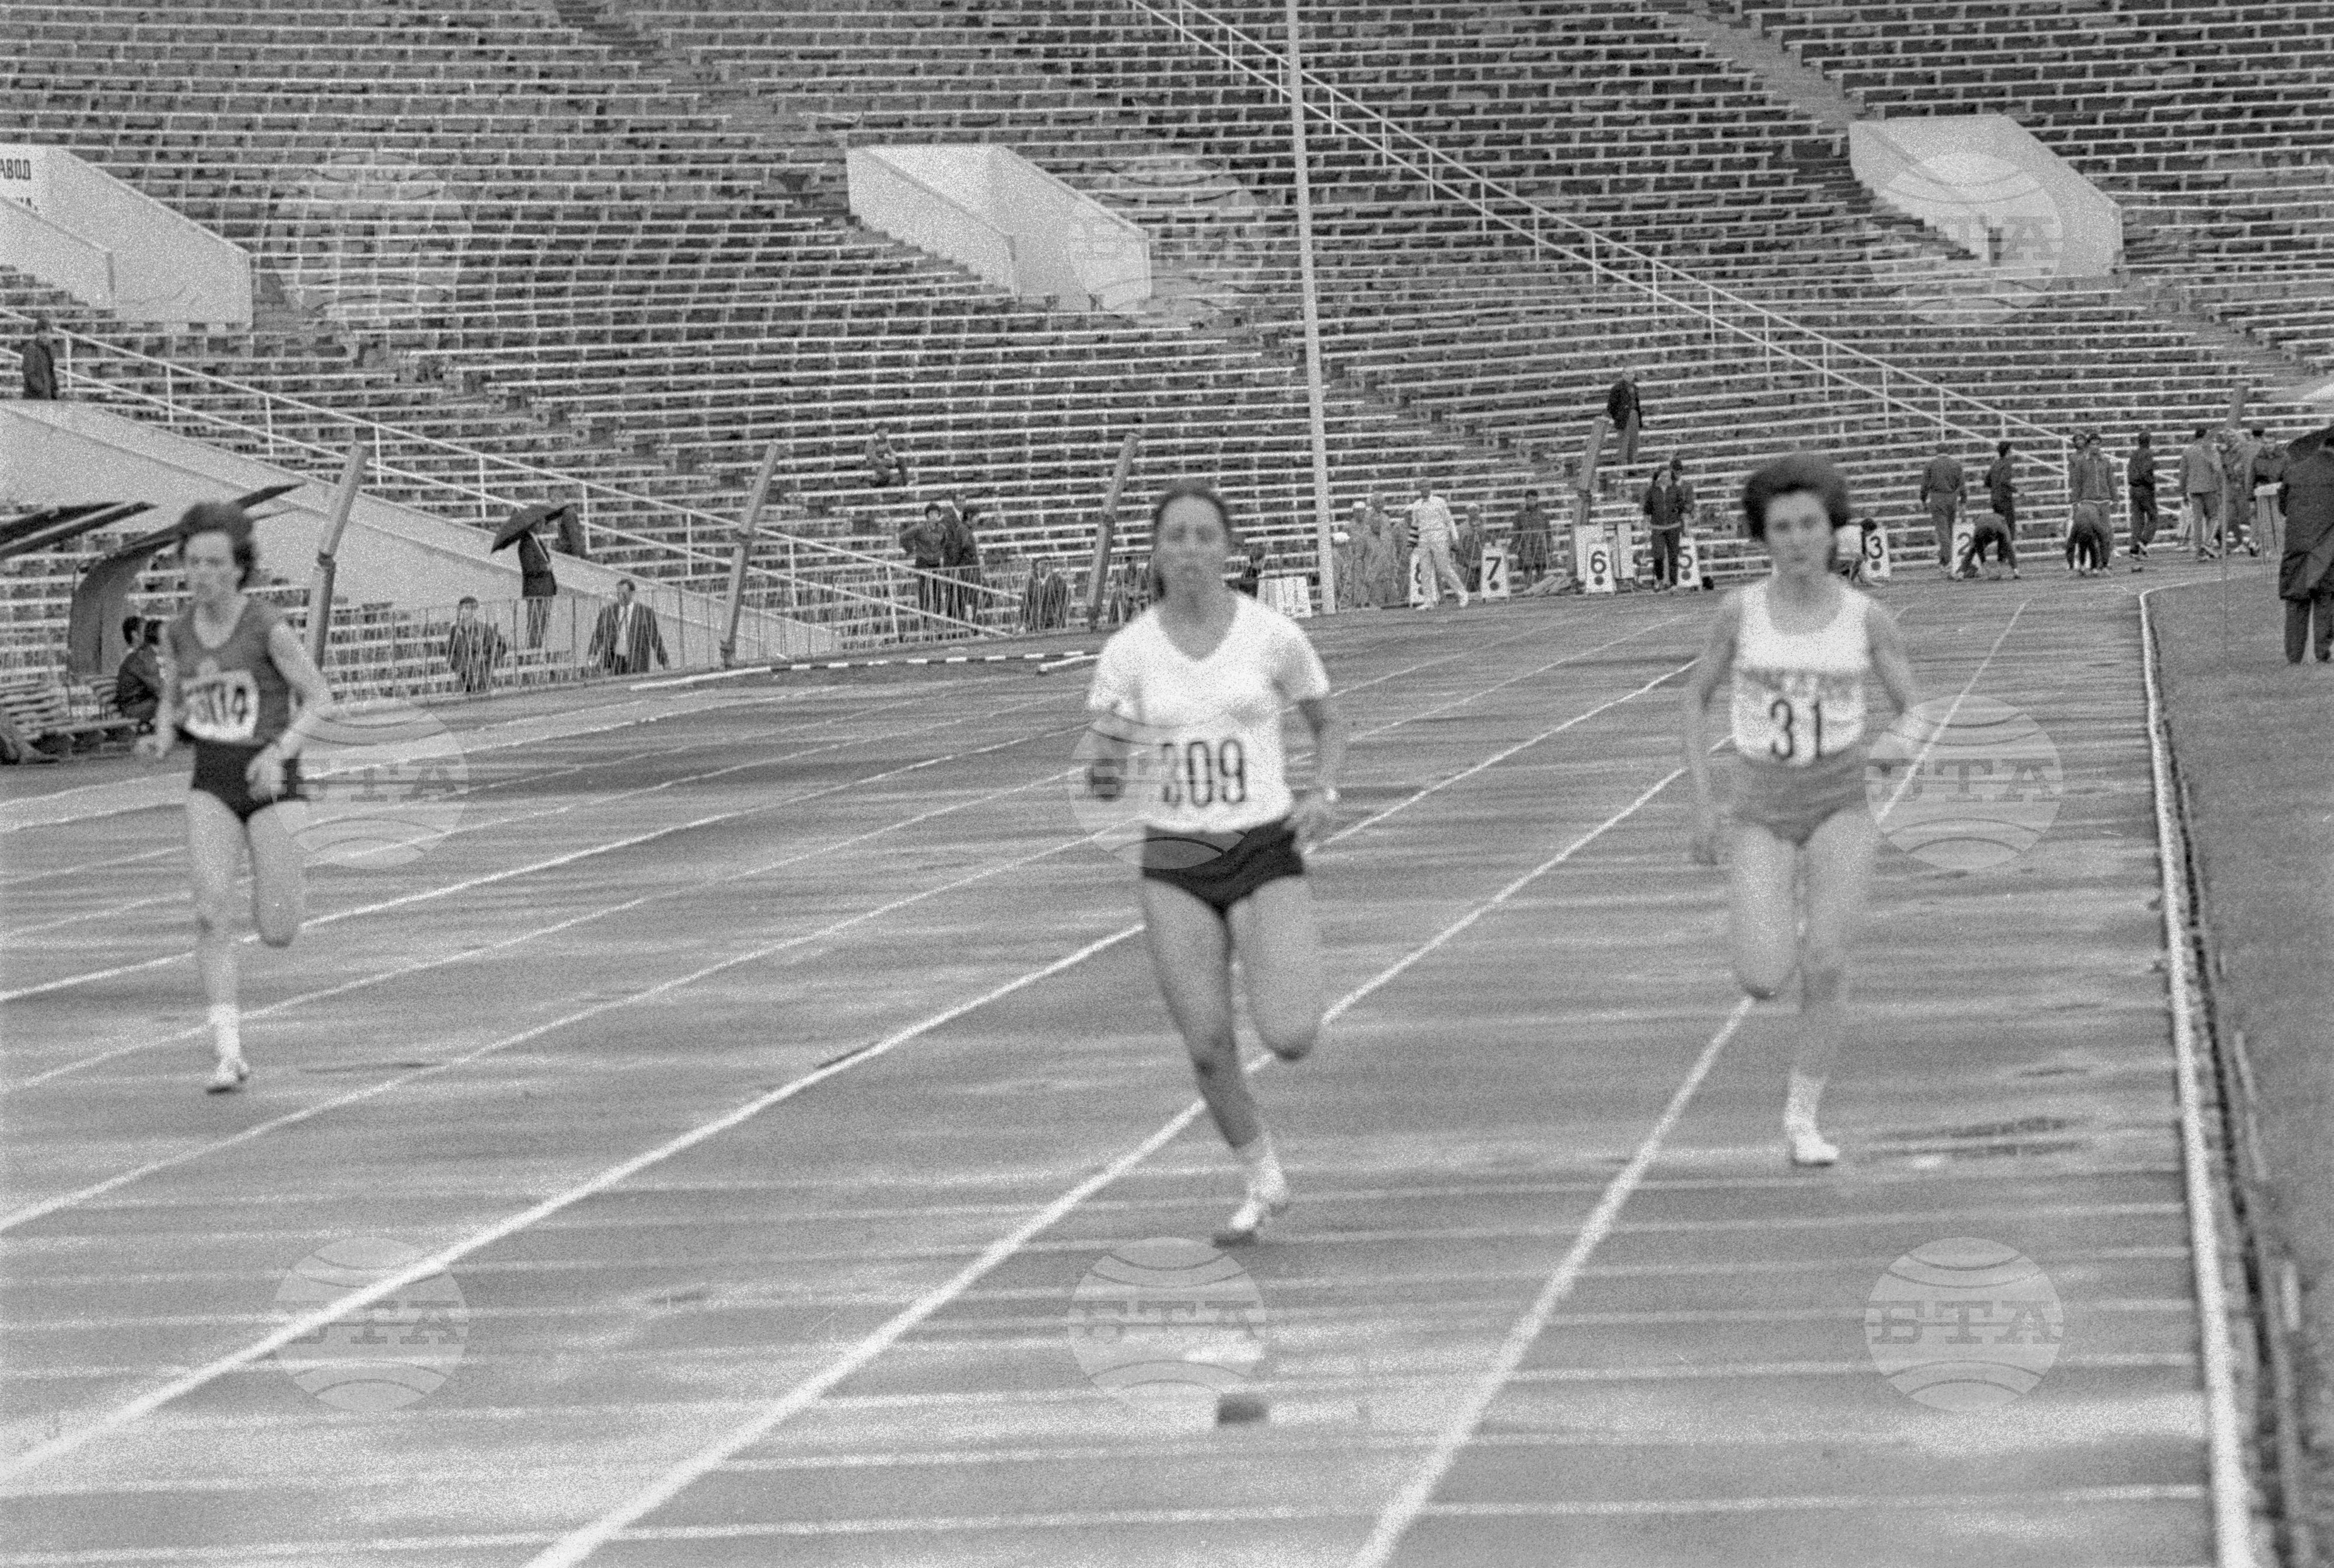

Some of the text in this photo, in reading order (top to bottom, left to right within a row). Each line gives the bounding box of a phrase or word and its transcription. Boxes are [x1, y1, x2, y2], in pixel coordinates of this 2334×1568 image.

[1678, 545, 1693, 570] 5
[1870, 536, 1884, 559] 3
[1485, 556, 1502, 581] 7
[1591, 551, 1606, 574] 6
[1769, 699, 1822, 760] 31
